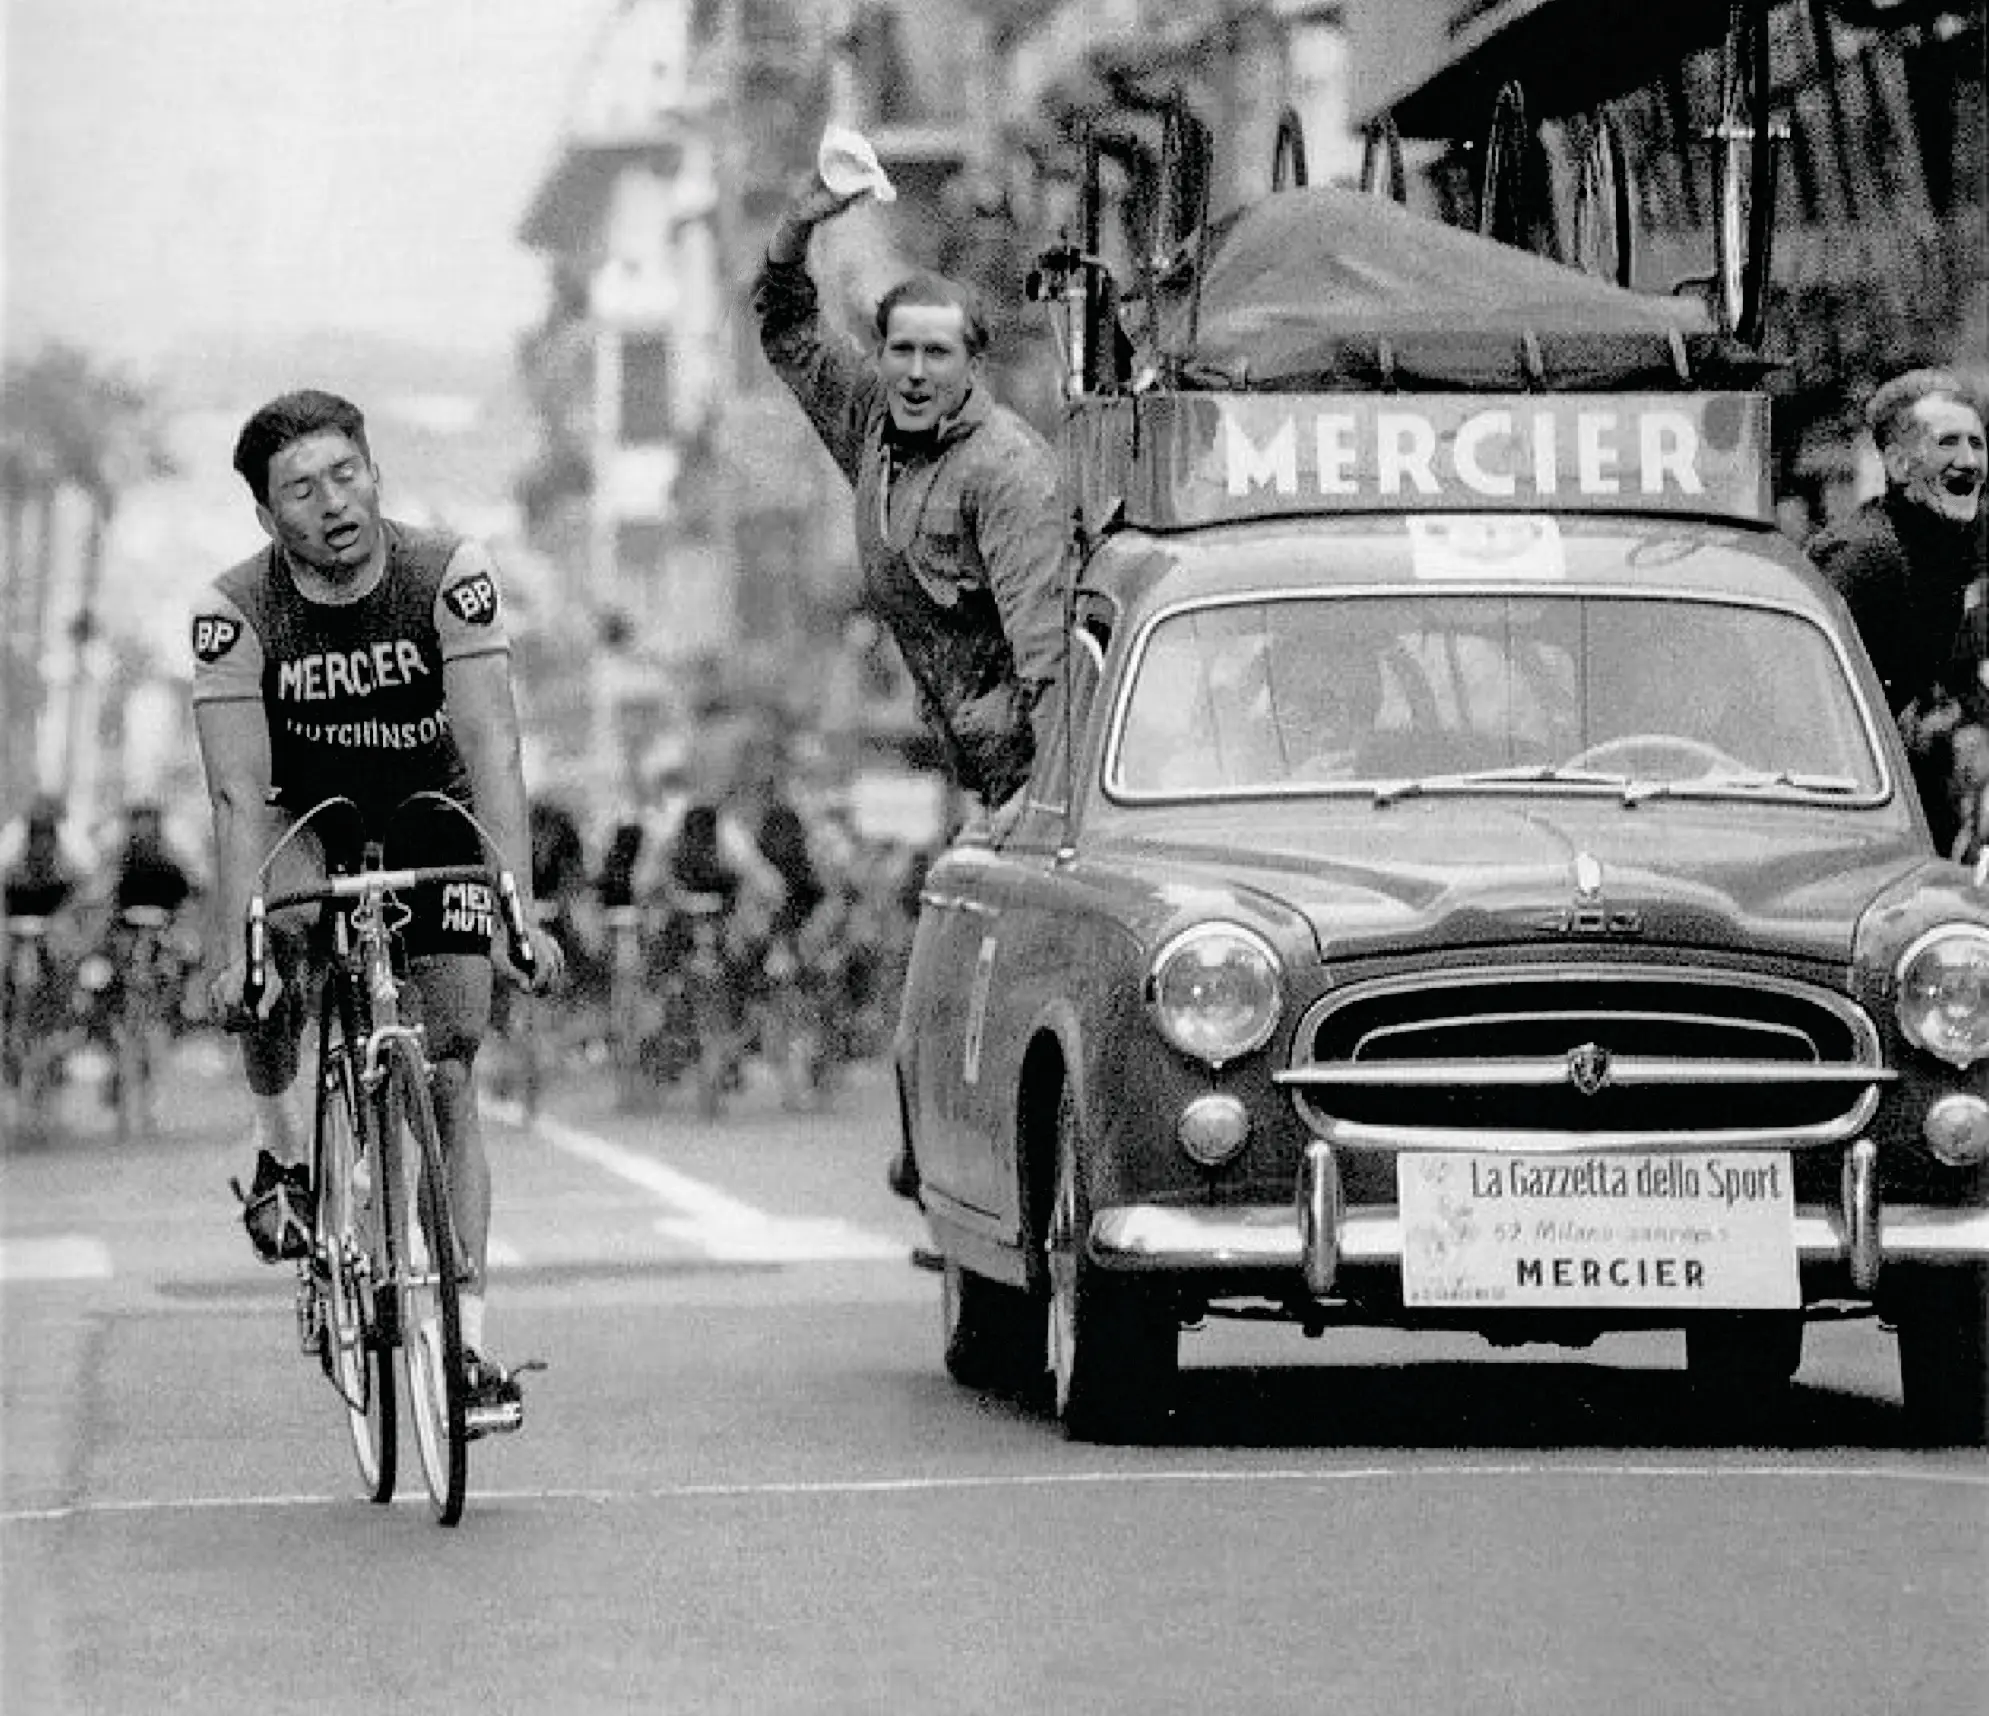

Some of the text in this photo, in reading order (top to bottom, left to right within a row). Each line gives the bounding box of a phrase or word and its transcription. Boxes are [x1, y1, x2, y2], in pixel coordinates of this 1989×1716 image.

[1225, 409, 1704, 496] MERCIER
[453, 580, 491, 617] BP
[198, 622, 234, 652] BP
[278, 639, 430, 702] MERCER
[1472, 1159, 1502, 1198] La
[1510, 1158, 1627, 1198] Gazzetta
[1637, 1158, 1700, 1198] dello
[1707, 1158, 1782, 1208] Sport
[1516, 1257, 1706, 1288] MERCIER
